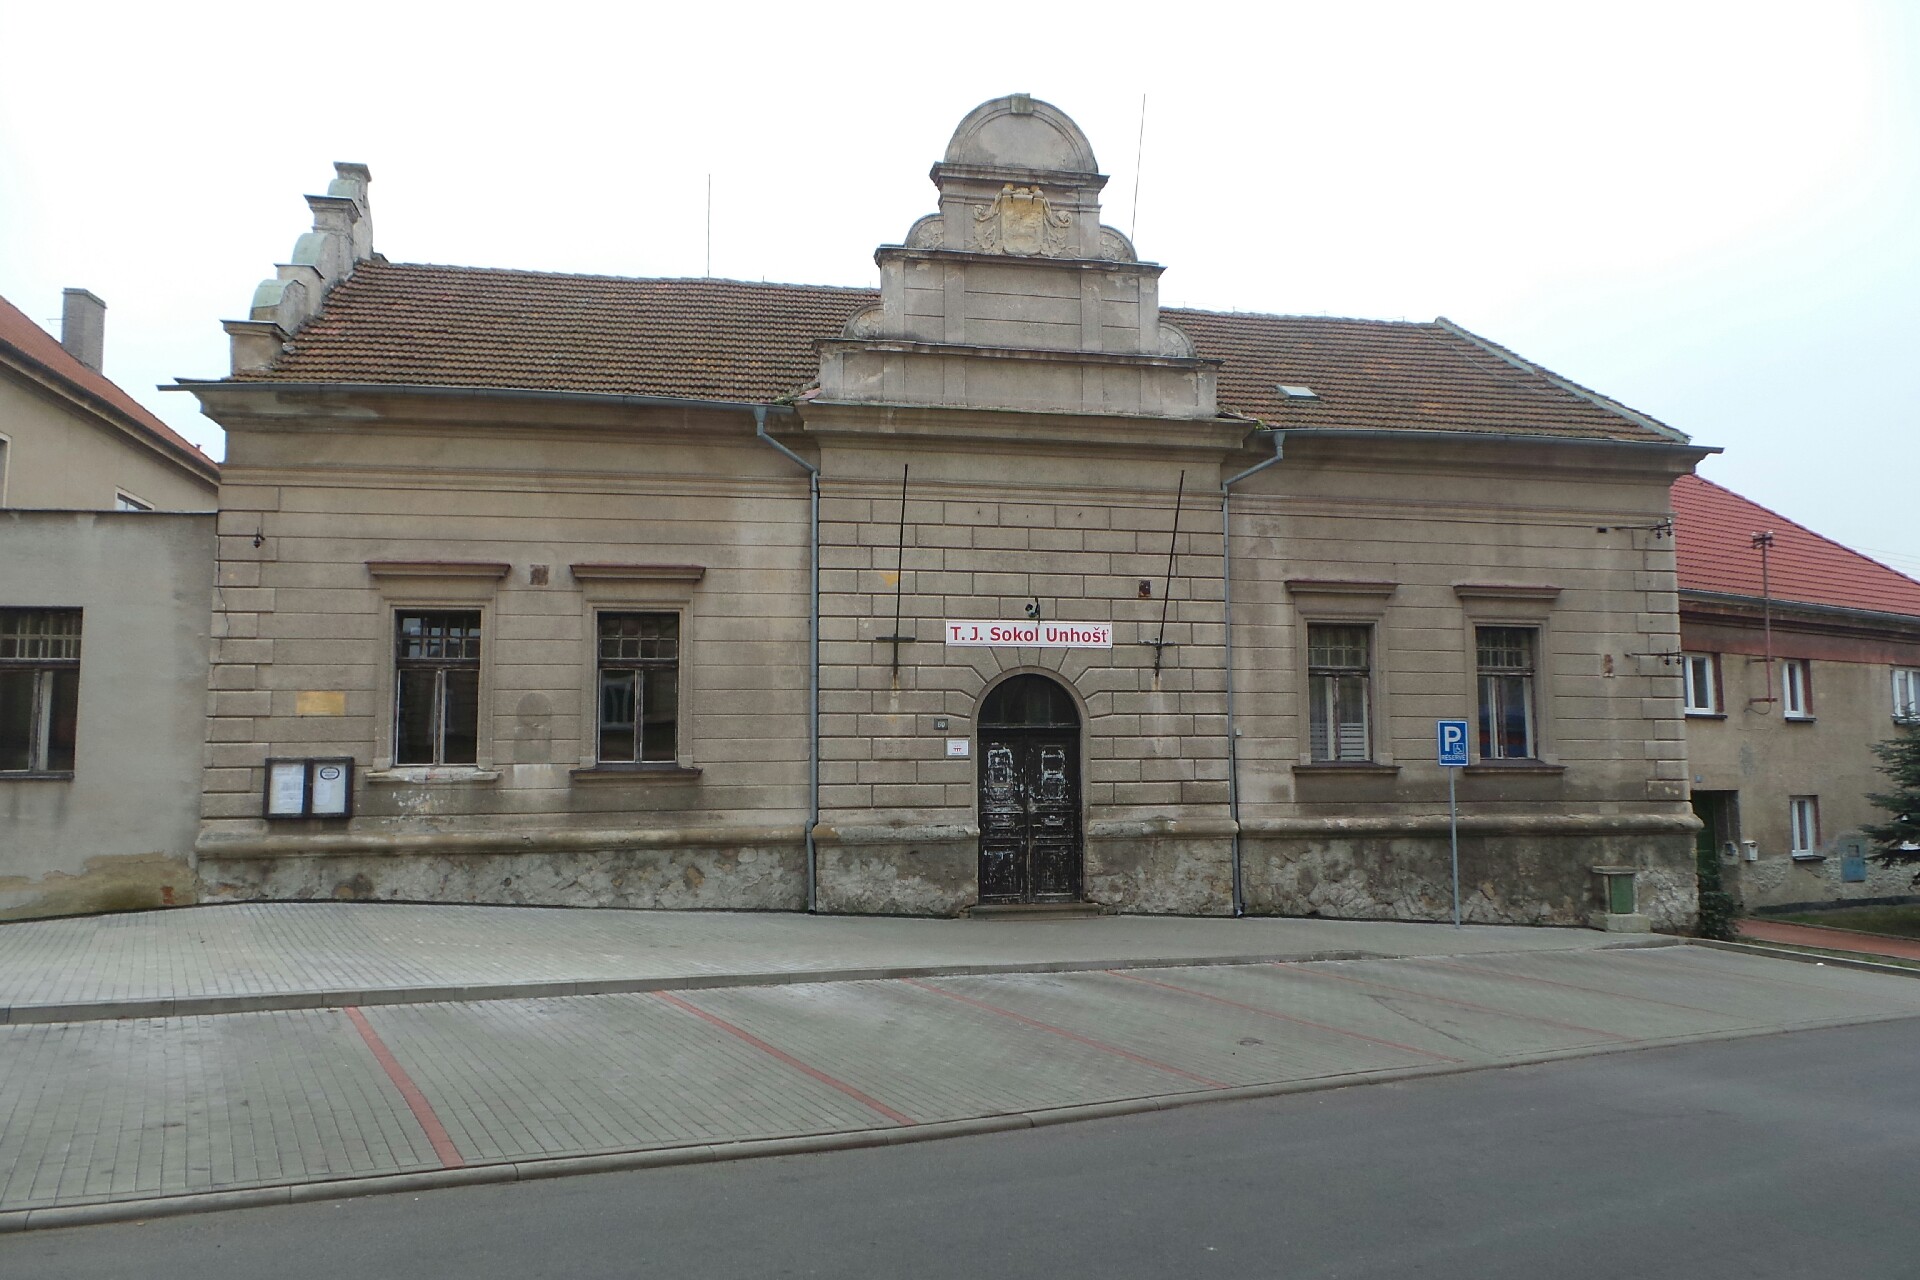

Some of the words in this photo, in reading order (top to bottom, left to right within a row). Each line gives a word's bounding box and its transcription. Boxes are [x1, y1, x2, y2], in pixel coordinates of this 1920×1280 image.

[990, 627, 1039, 642] Sokol
[1046, 626, 1109, 643] Unhošť
[1444, 726, 1461, 751] P
